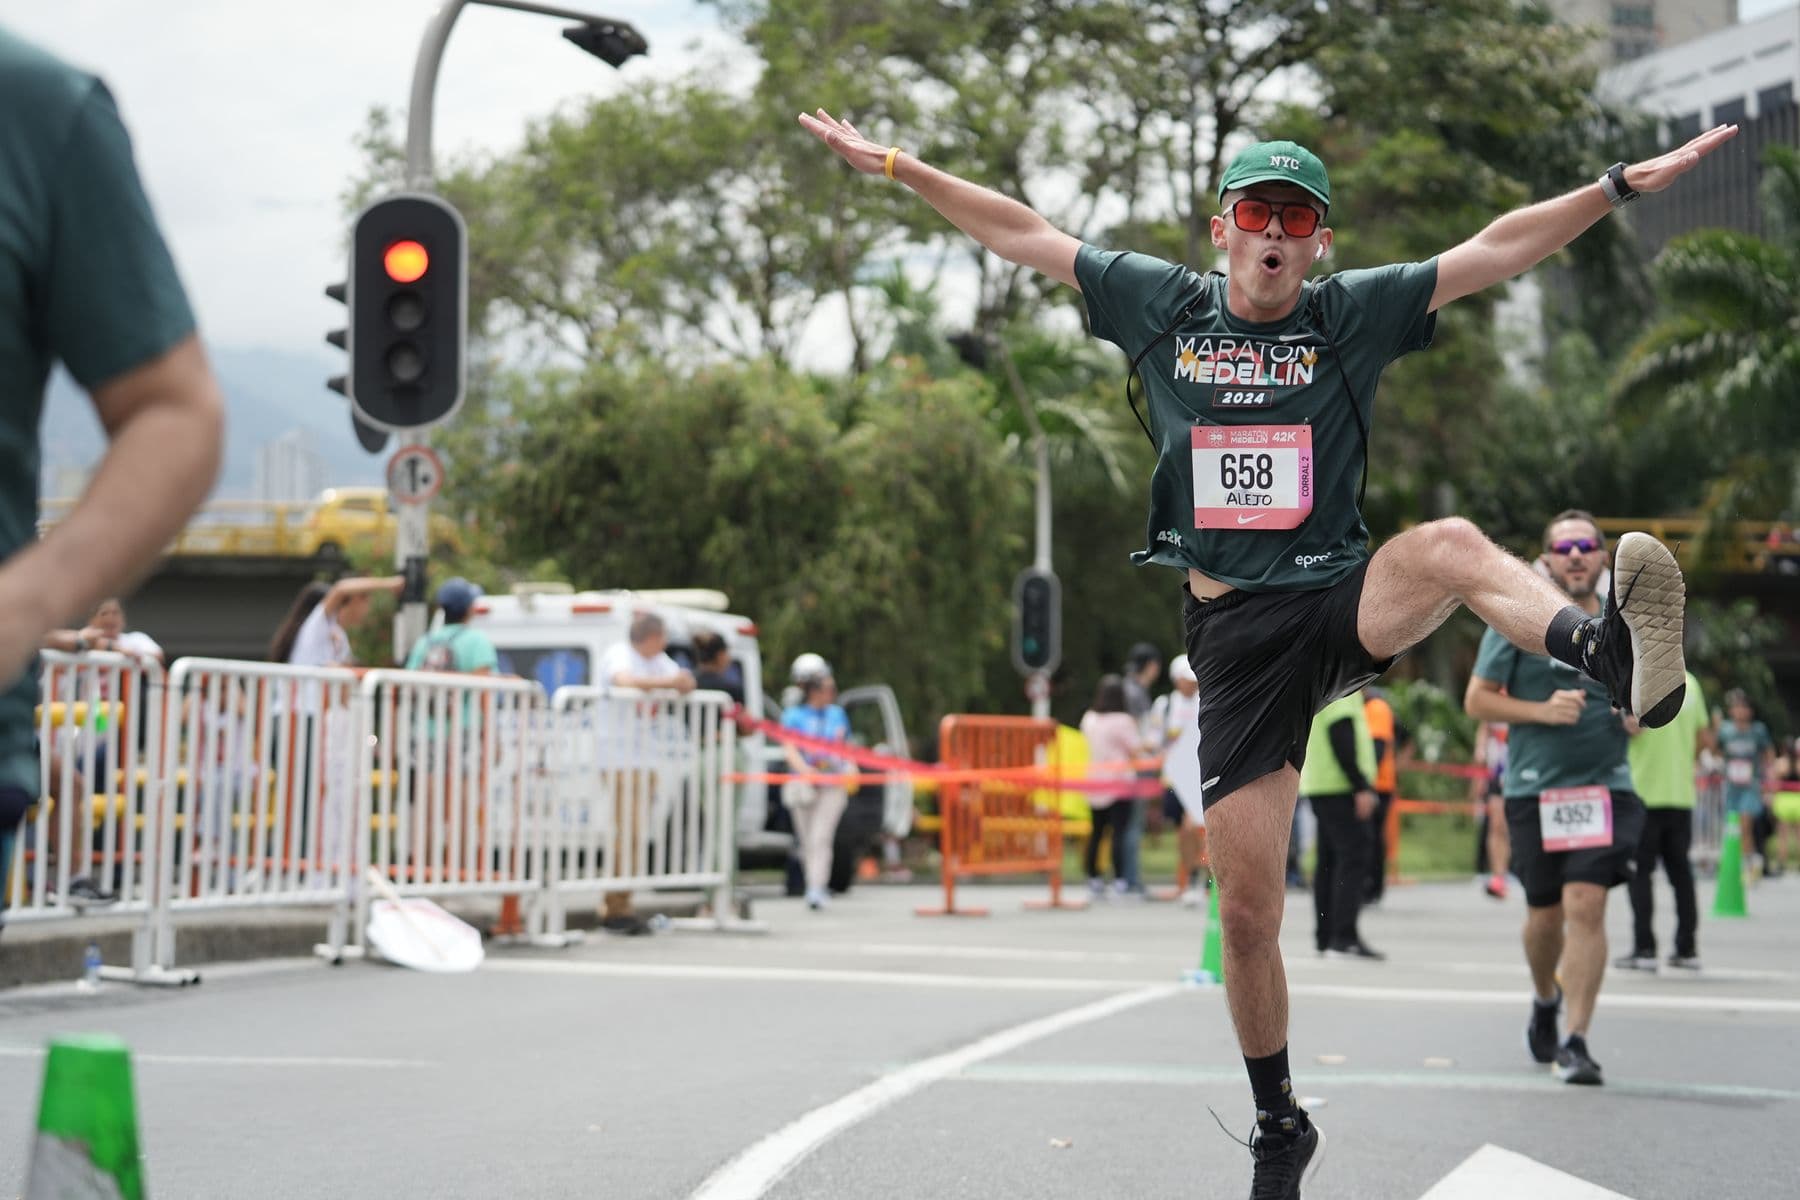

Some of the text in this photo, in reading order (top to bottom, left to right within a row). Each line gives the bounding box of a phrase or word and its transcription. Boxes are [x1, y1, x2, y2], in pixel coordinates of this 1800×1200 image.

[1270, 155, 1300, 170] NYC
[1174, 357, 1314, 386] MEDELLÍN
[1222, 391, 1265, 405] 2024
[1272, 431, 1297, 442] 42K
[1220, 453, 1274, 490] 658
[1301, 464, 1310, 497] CORRAL
[1226, 491, 1273, 506] ALEJO
[1156, 530, 1182, 547] 42K
[1553, 803, 1593, 824] 4352
